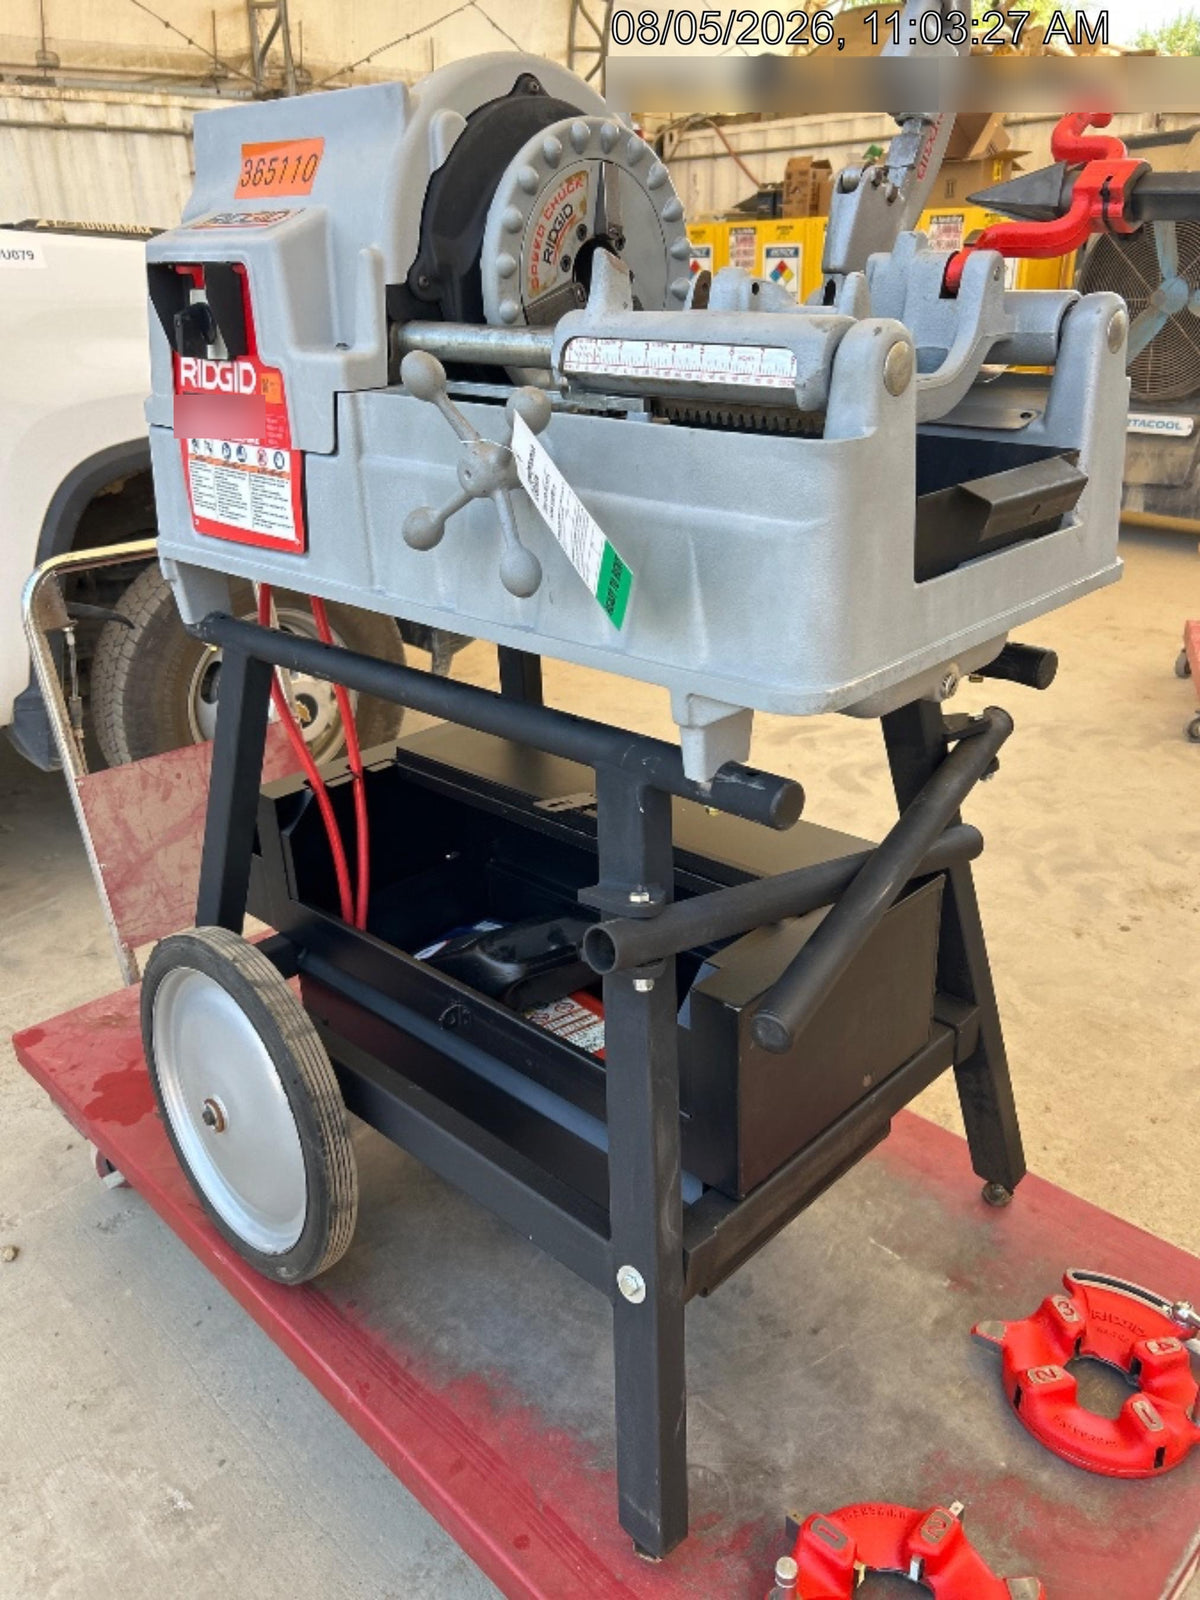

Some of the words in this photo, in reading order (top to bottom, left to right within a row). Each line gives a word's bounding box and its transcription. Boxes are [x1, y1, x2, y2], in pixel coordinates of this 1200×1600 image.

[241, 153, 319, 188] 365110
[543, 203, 574, 266] RIDGID
[180, 357, 257, 395] RIDGID
